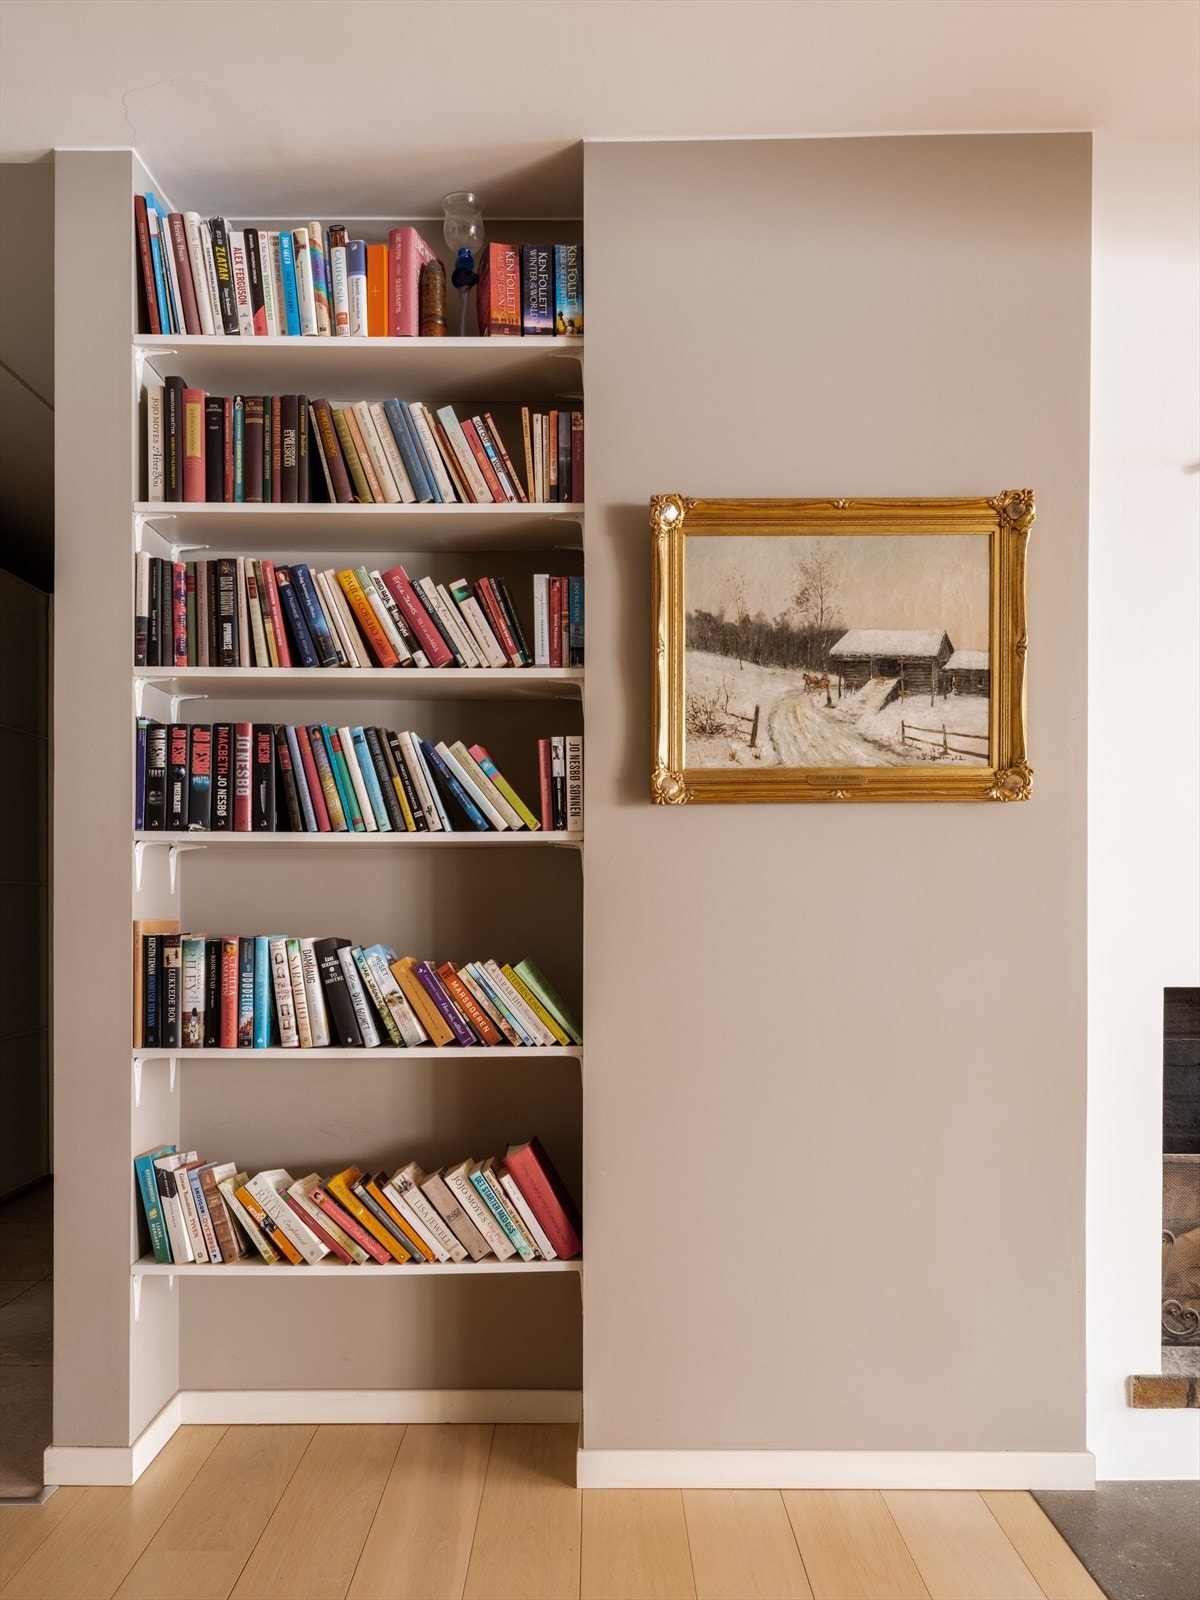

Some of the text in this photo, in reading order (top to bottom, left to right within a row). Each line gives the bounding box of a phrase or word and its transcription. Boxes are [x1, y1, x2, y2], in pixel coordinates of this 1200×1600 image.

[173, 220, 186, 261] Henrik Ibsen
[188, 220, 200, 260] Henrik Ibsen
[215, 245, 229, 281] ZLATAN
[233, 246, 247, 305] ALEX FERGUSON
[334, 249, 343, 304] CALIFORNIA
[497, 271, 504, 281] OF
[505, 251, 515, 314] KEN FOLLETT
[529, 248, 537, 281] WINTER
[560, 264, 566, 274] OF
[567, 245, 576, 310] KEN FOLLETT
[263, 274, 273, 320] SUPERSTUDENT
[538, 252, 547, 315] KEN FOLLETT
[151, 397, 159, 414] JOJO
[152, 445, 161, 469] After
[474, 419, 502, 474] GET OUT WAY
[152, 470, 161, 486] You
[220, 576, 233, 615] DAN BROWN
[372, 575, 391, 604] ABID RAJA
[392, 574, 418, 615] Erica James
[343, 574, 388, 656] PAULO COELHO Zahir
[390, 608, 401, 622] Min
[150, 728, 166, 768] JO NESBØ
[171, 727, 186, 764] JO NESBØ
[192, 728, 211, 775] JO NESBØ
[236, 734, 250, 796] JO NESBØ
[258, 732, 270, 763] JO NESBØ
[217, 730, 228, 816] MACBETH JO NESBØ
[569, 742, 580, 817] JO NESBØ SØNNEN
[184, 949, 196, 993] RILEY
[228, 956, 236, 995] CECILIA
[302, 949, 315, 983] DAMHAUG
[356, 955, 363, 963] VI
[360, 964, 370, 977] VAR
[374, 954, 388, 977] HUSET
[494, 973, 513, 996] SARAH
[242, 972, 252, 1014] UDØDELIGE
[289, 955, 306, 1019] SARAH JIO
[352, 991, 362, 1006] DIN
[450, 980, 489, 1033] MARSBOEREN
[506, 971, 542, 1013] STEPHEN KING
[255, 1188, 282, 1221] RILEY
[450, 1174, 487, 1224] JOJO MOYES
[474, 1175, 516, 1234] DET STARTER MED OSS
[151, 1223, 159, 1249] MORIARTY
[189, 1217, 198, 1238] TYVEN
[413, 1199, 452, 1246] LISA JEWELL
